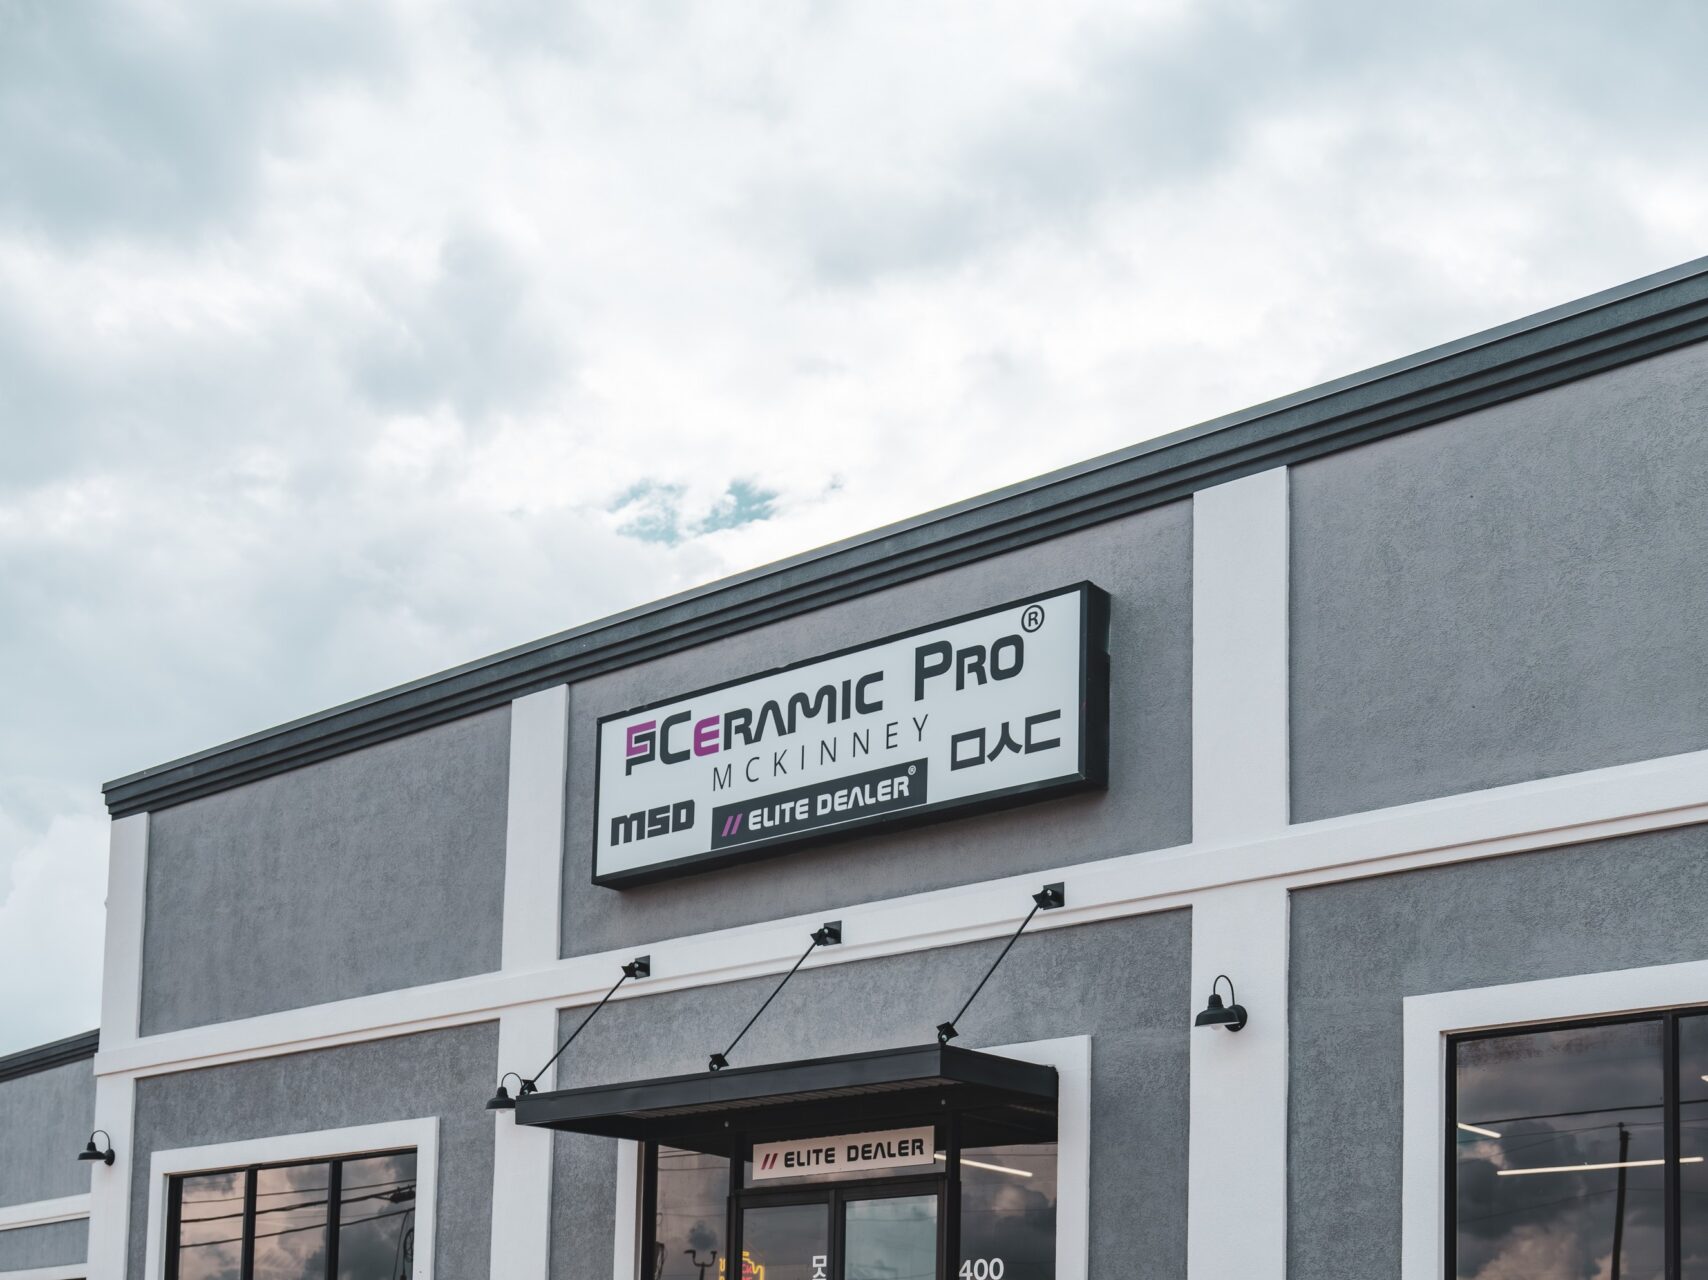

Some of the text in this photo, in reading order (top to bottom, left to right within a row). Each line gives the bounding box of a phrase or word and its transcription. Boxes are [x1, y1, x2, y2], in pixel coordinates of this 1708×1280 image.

[712, 713, 929, 792] MCKINNEY
[748, 797, 809, 831] ELITE
[784, 1138, 925, 1169] ELITE DEALER
